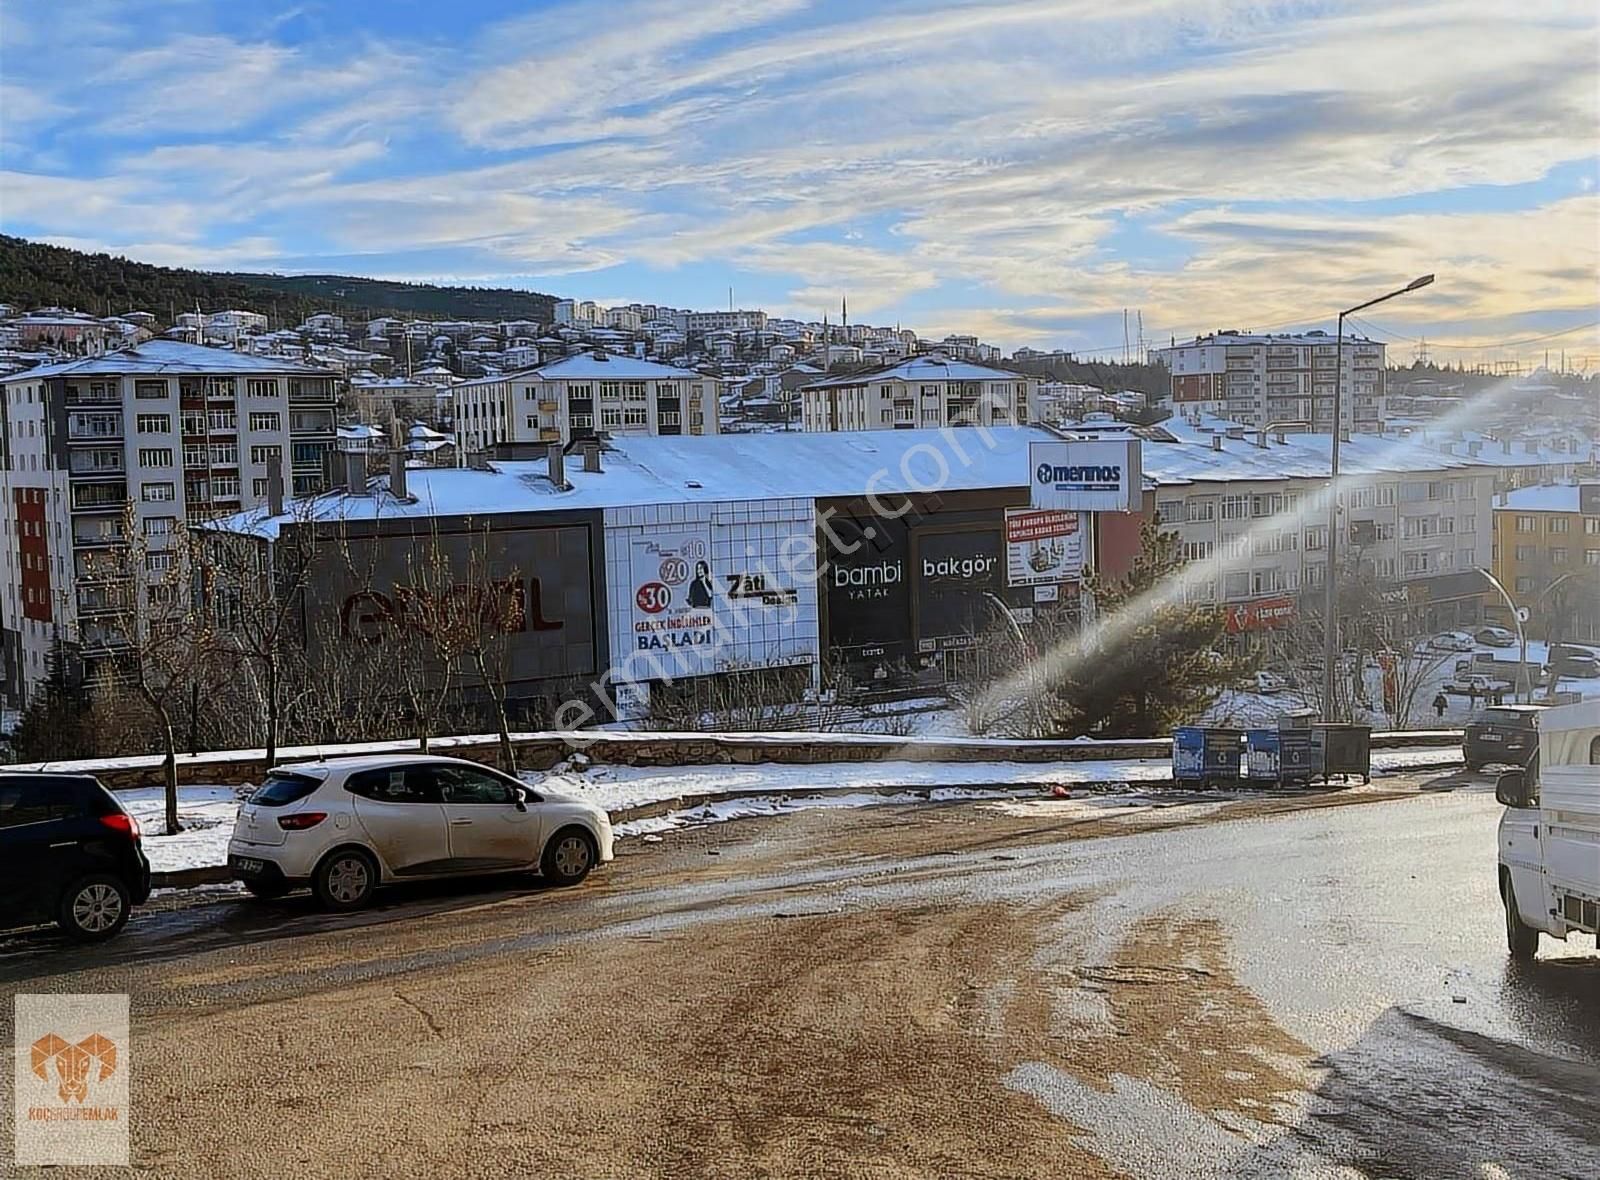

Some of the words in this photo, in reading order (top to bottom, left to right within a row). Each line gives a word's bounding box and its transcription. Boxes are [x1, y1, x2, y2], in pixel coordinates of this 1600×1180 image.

[835, 560, 902, 587] bambi
[923, 554, 993, 578] bakgör
[637, 629, 712, 651] BAŞLADI
